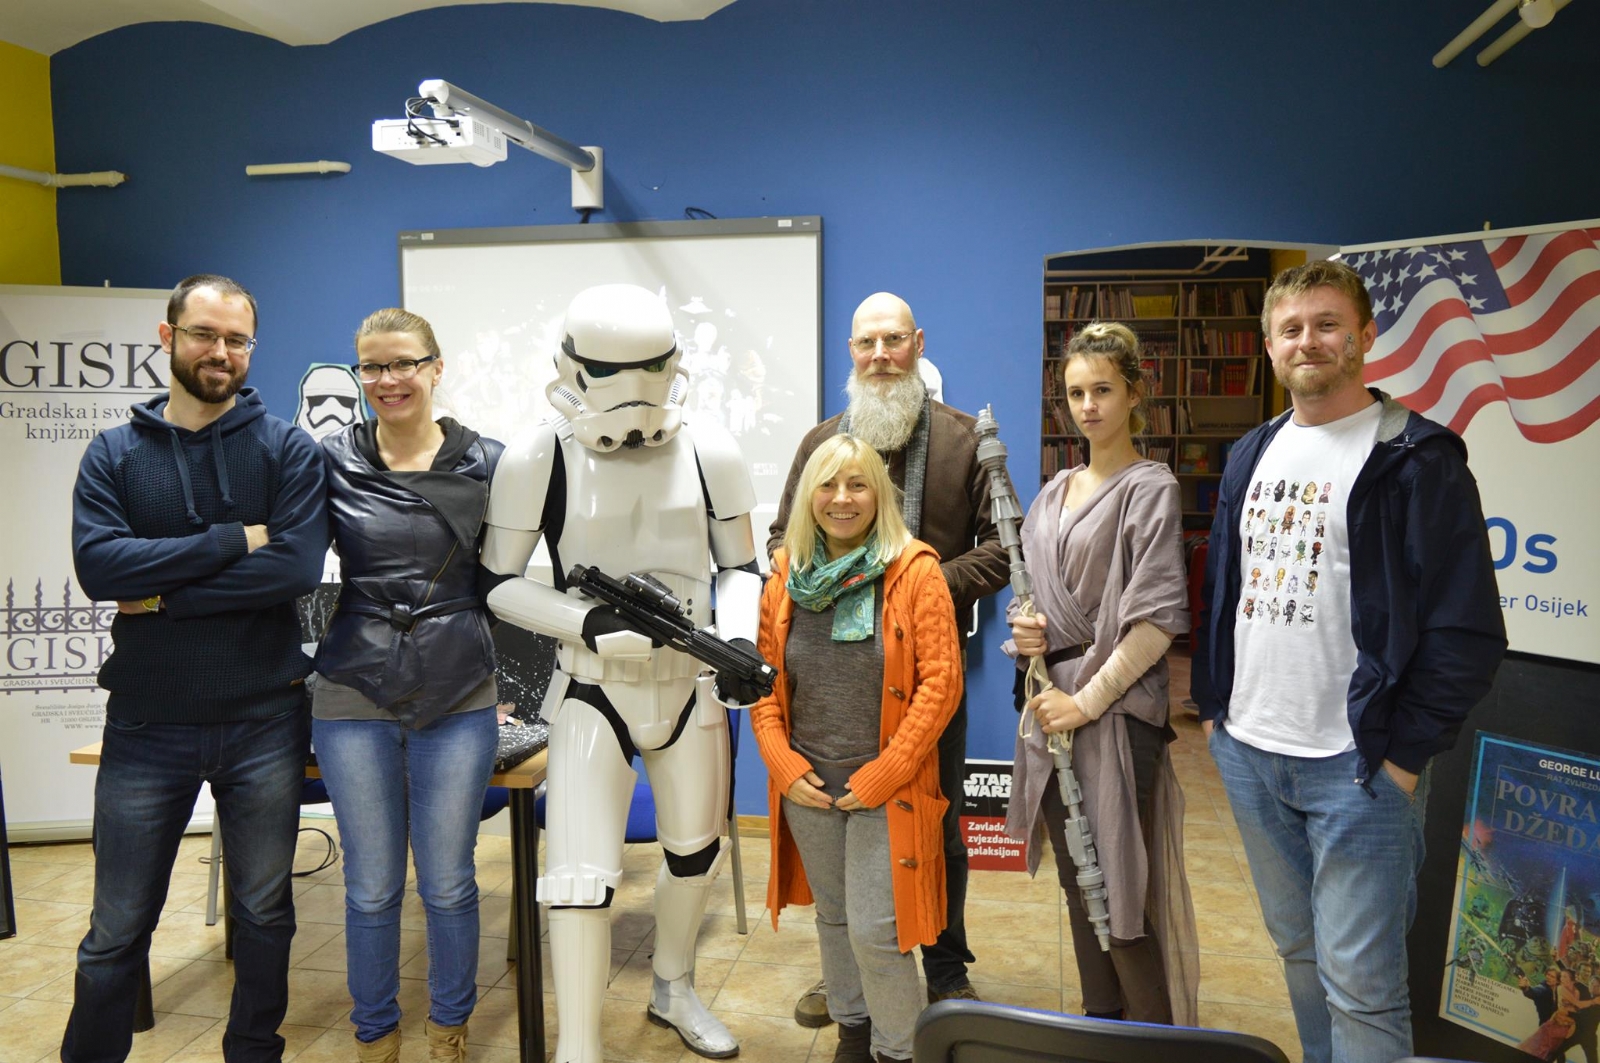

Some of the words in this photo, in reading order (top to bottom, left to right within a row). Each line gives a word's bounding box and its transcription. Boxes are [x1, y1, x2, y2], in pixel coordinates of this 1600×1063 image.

[0, 340, 169, 389] GISK
[0, 401, 87, 419] Gradska
[92, 402, 99, 419] i
[1525, 594, 1588, 618] Osijek
[3, 679, 43, 687] GRADSKA
[1539, 759, 1587, 778] GEORGE
[963, 773, 1012, 786] STAR
[963, 784, 1012, 798] WARS
[967, 846, 1020, 858] galaksijom
